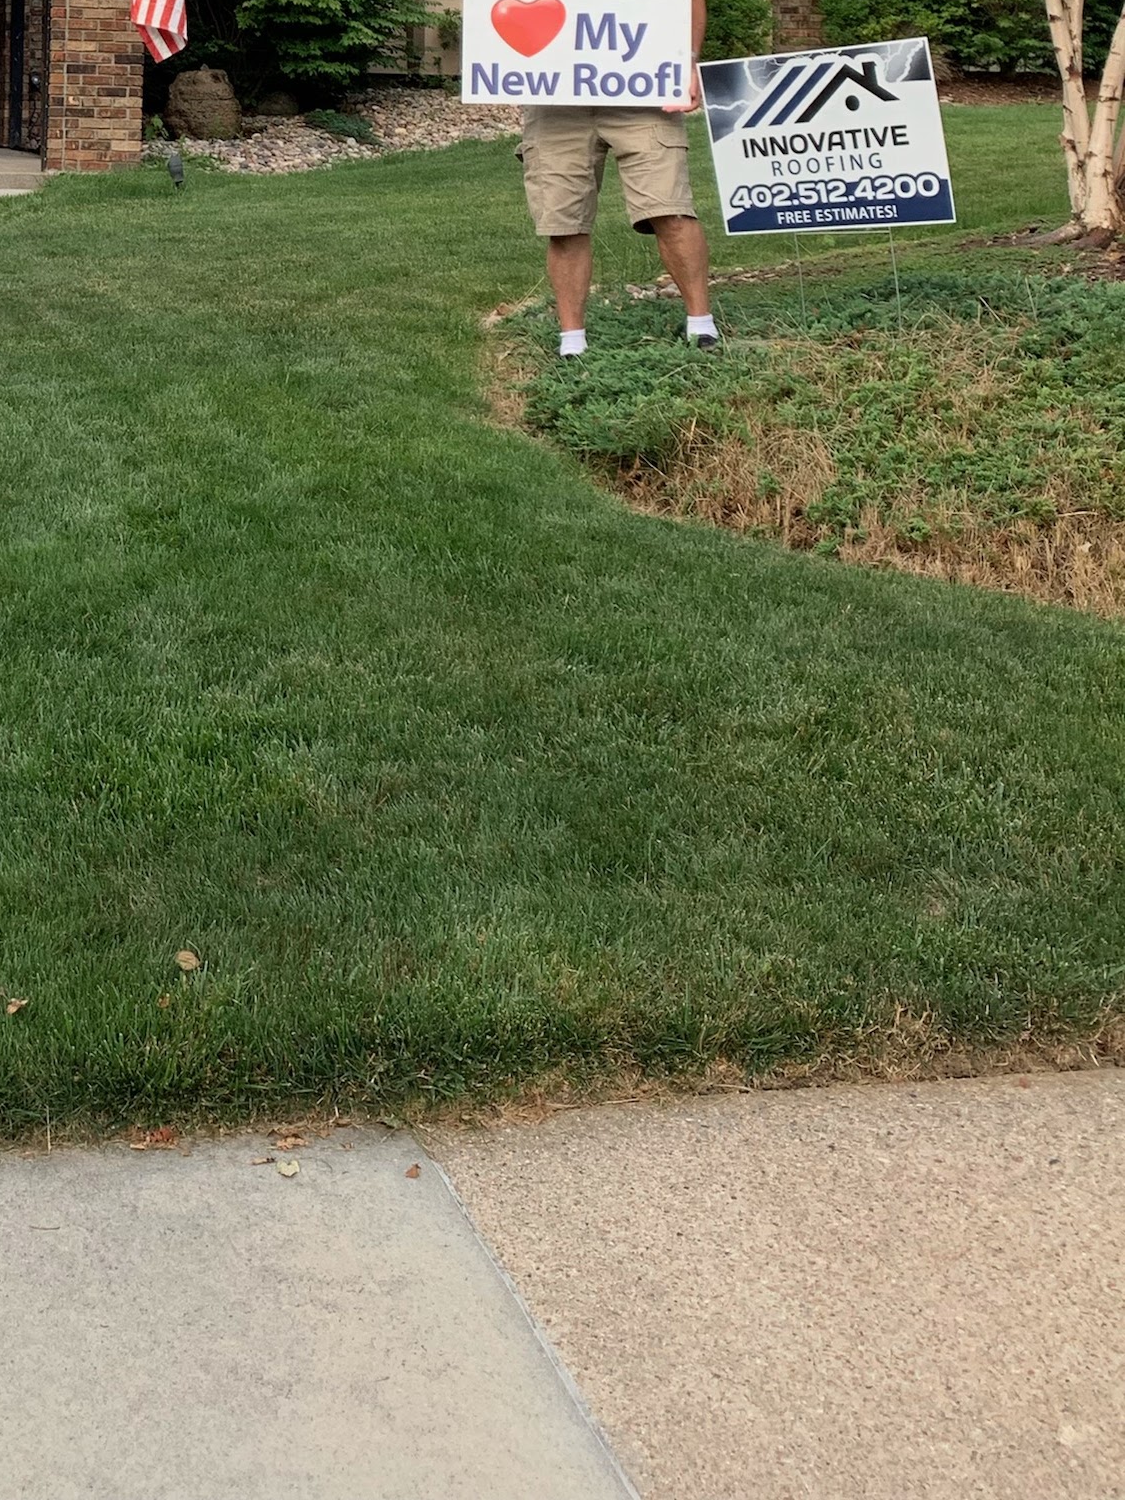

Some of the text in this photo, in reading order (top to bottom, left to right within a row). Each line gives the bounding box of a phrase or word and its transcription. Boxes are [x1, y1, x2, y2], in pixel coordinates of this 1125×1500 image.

[575, 12, 648, 62] My
[471, 61, 682, 97] New Roof!
[742, 125, 910, 158] INNOVATIVE
[771, 152, 884, 177] ROOFING
[730, 172, 941, 209] 402.512.4200
[777, 205, 898, 225] FREE ESTIMATES!
